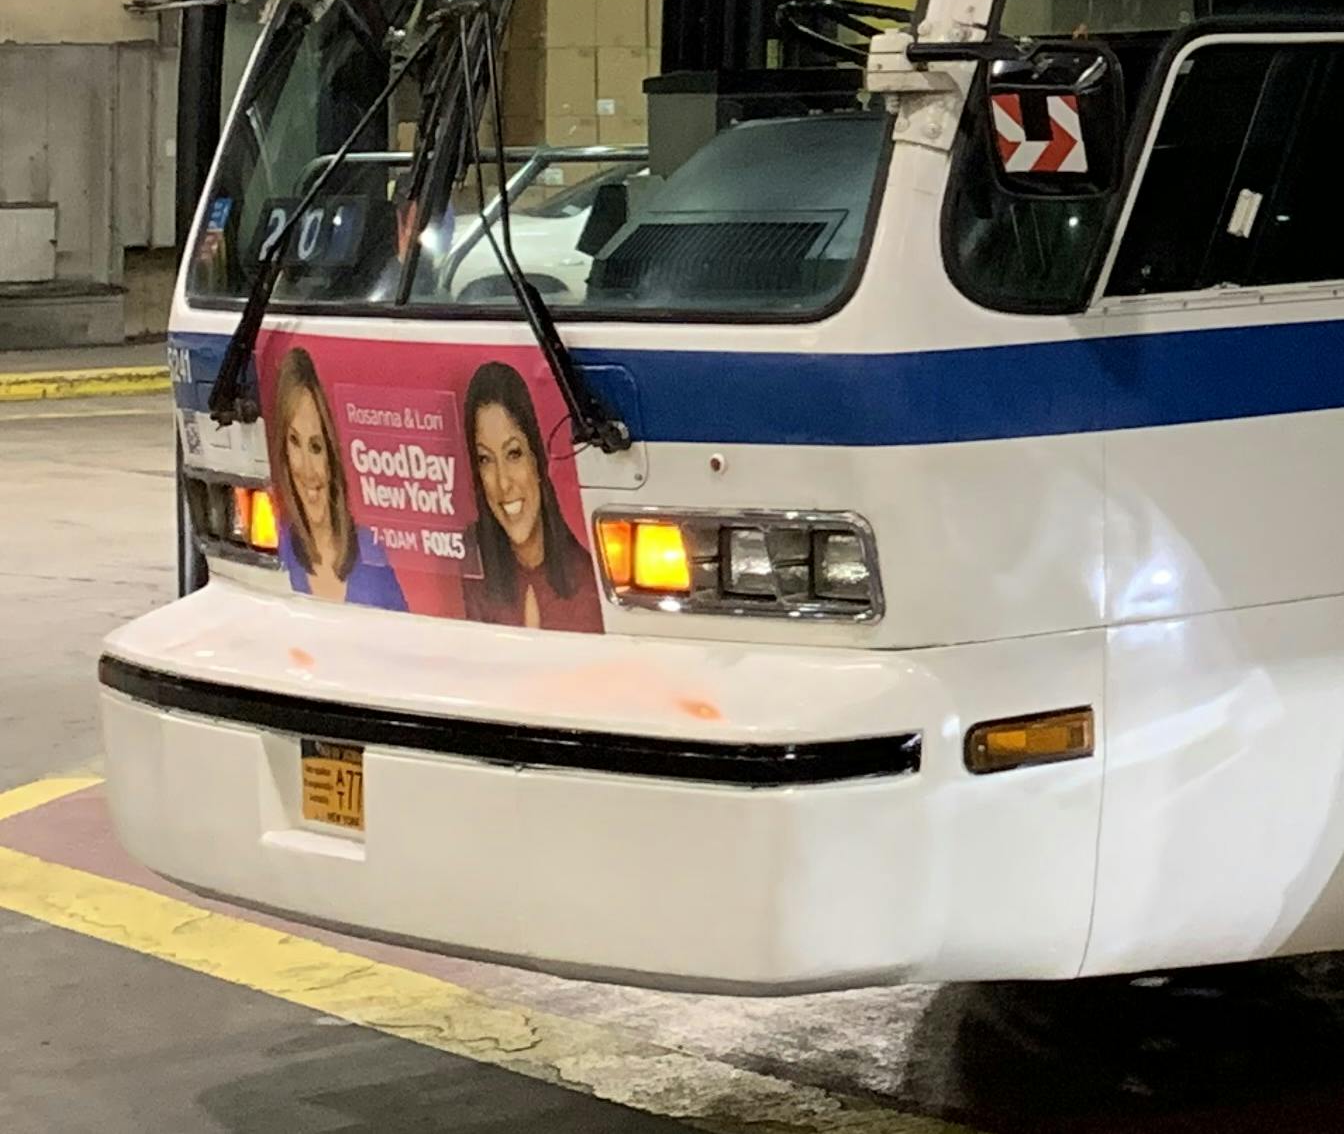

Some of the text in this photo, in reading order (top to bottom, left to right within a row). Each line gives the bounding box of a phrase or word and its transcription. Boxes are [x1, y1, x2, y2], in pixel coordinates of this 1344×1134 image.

[346, 403, 444, 431] Rosanna & Lori
[351, 438, 455, 492] Good Day
[360, 475, 455, 516] New York
[370, 526, 418, 552] 7-10AM
